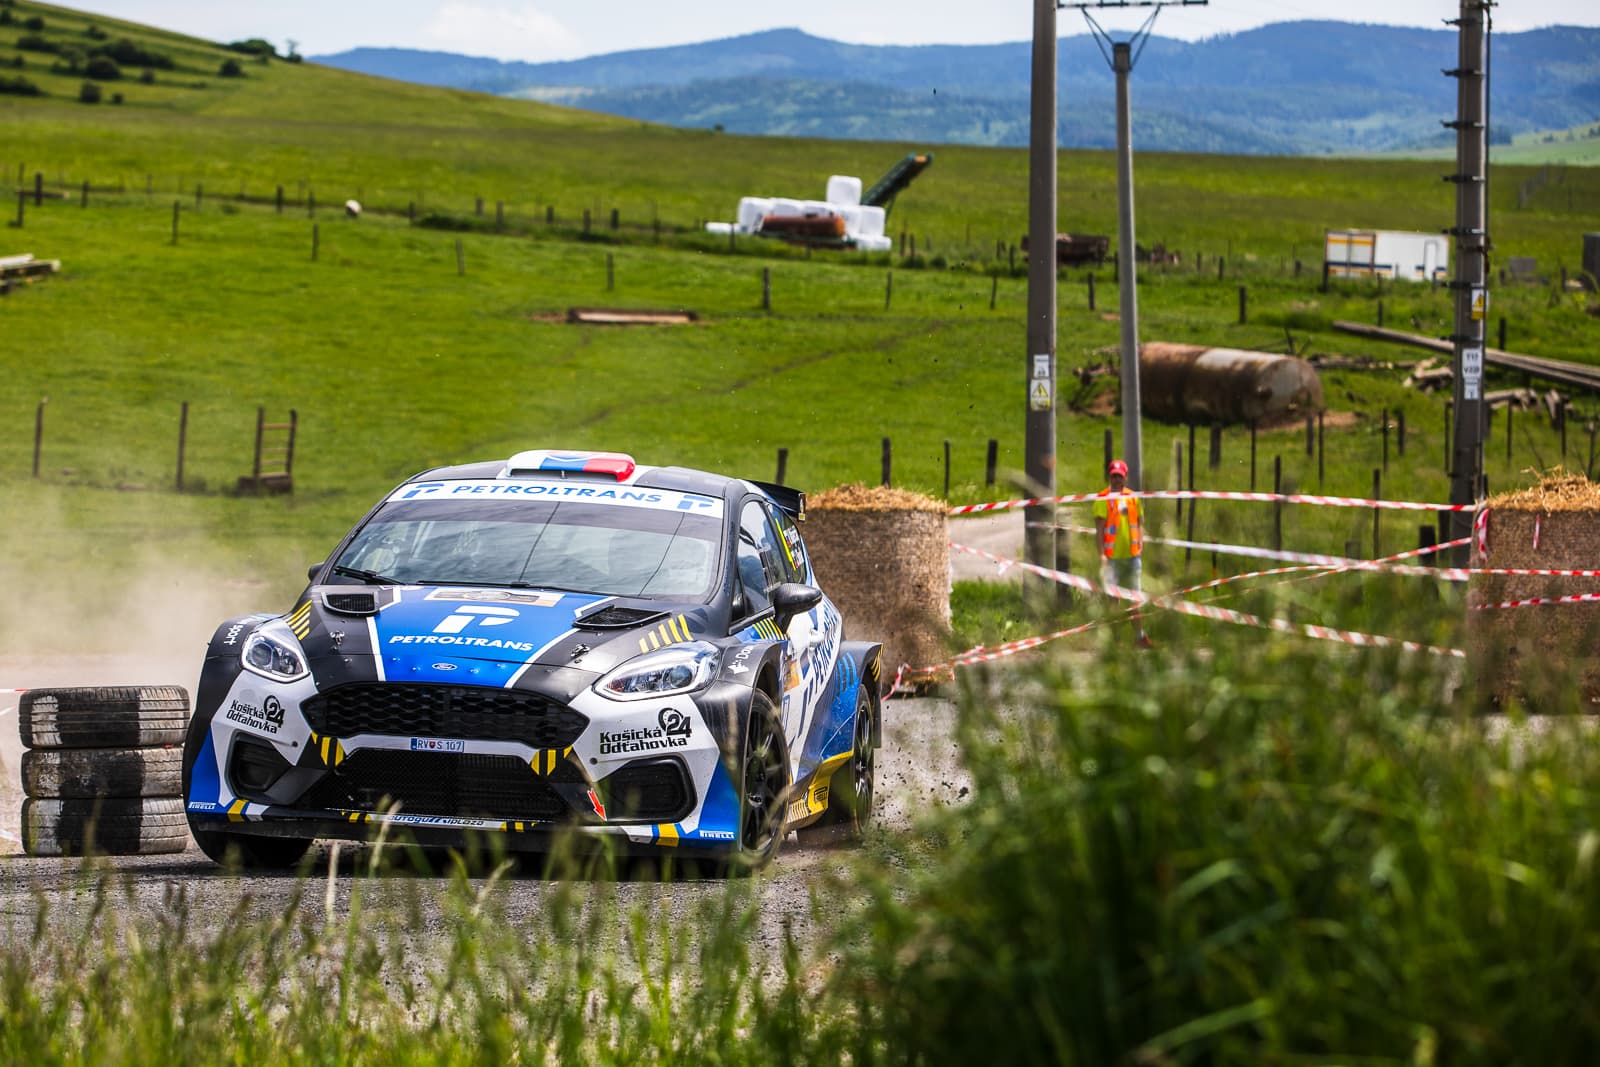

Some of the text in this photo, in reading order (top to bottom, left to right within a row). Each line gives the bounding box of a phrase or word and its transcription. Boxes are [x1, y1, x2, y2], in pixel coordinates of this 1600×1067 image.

[452, 485, 662, 502] PETROLTRANS
[388, 635, 534, 651] PETROLTRANS
[231, 699, 286, 728] Košická 24
[600, 713, 692, 744] Košická 24
[417, 739, 429, 749] RV
